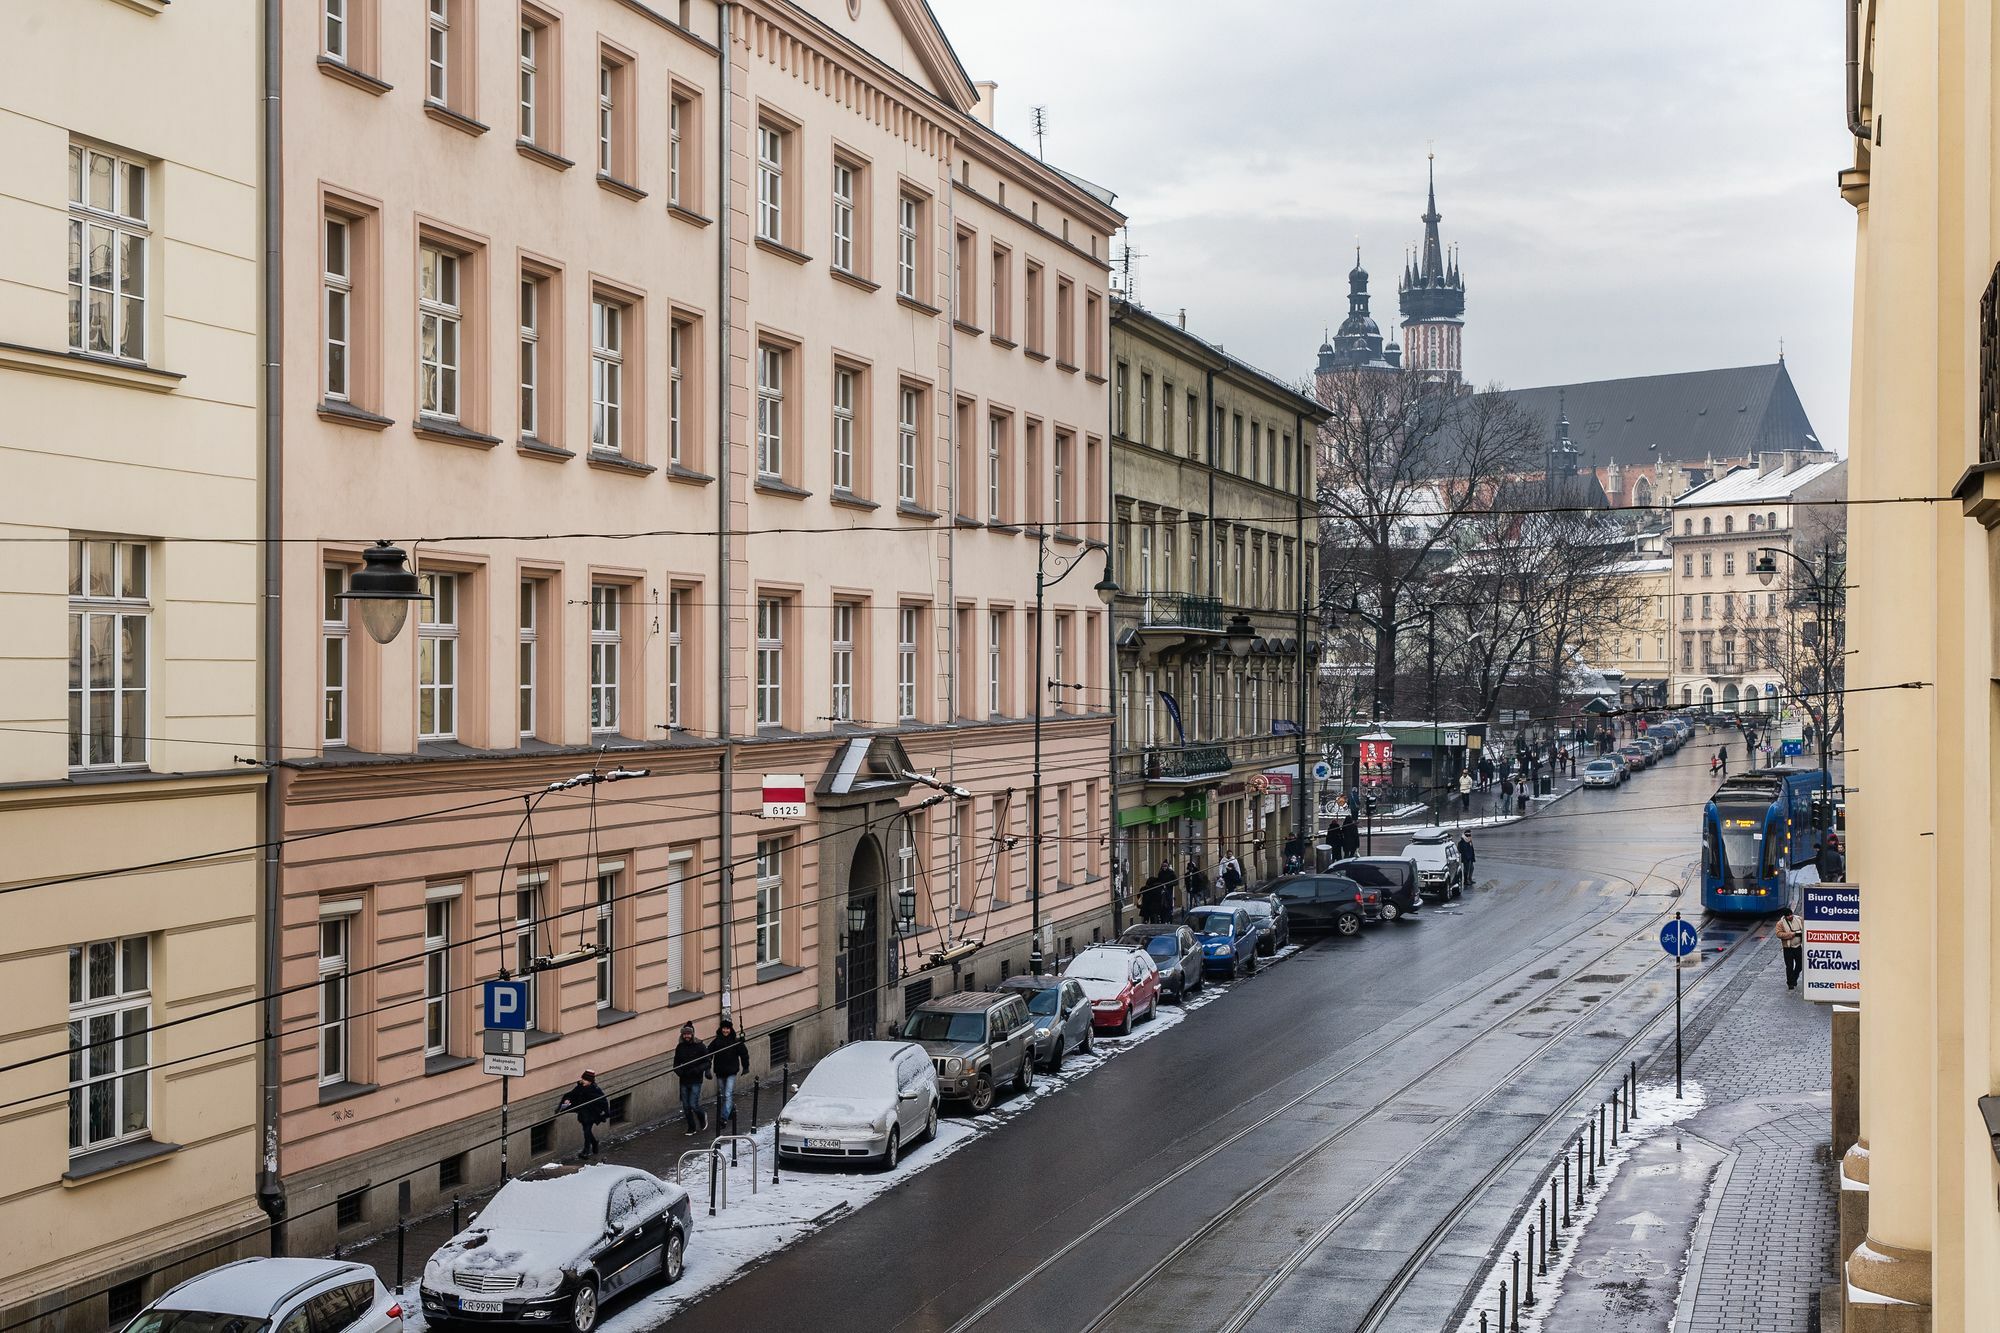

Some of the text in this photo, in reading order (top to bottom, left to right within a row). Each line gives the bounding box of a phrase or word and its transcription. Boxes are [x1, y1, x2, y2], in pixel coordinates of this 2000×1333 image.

[772, 806, 799, 815] 6125
[1725, 819, 1731, 828] 3
[1808, 893, 1833, 901] Biuro
[1807, 931, 1842, 941] DZIENNIK
[1807, 949, 1843, 959] GAZETA
[494, 986, 518, 1023] P
[808, 1139, 818, 1147] SC
[463, 1301, 474, 1311] KR
